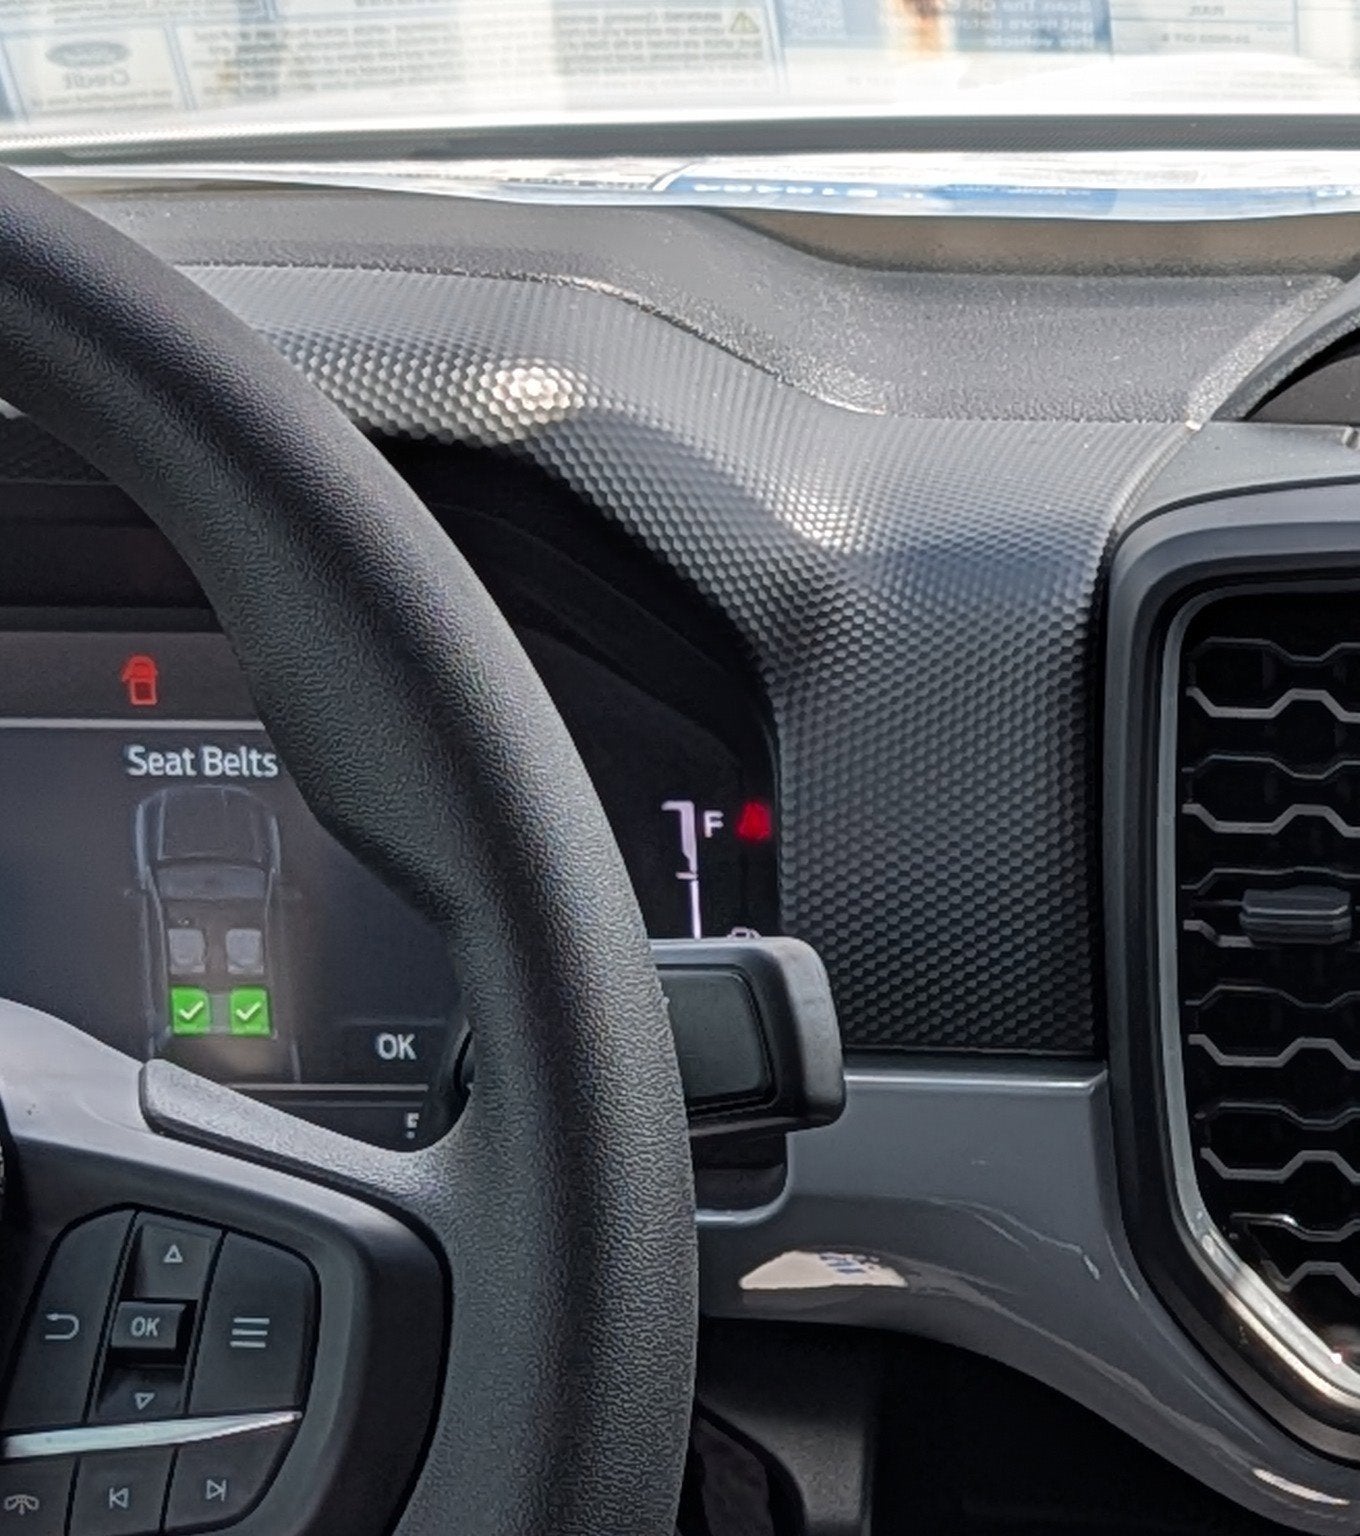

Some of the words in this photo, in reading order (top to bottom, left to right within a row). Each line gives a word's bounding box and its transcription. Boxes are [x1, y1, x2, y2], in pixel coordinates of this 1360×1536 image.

[127, 745, 197, 776] Seat
[201, 745, 279, 778] Belts
[703, 810, 724, 838] F
[376, 1033, 416, 1060] OK
[130, 1316, 160, 1337] OK
